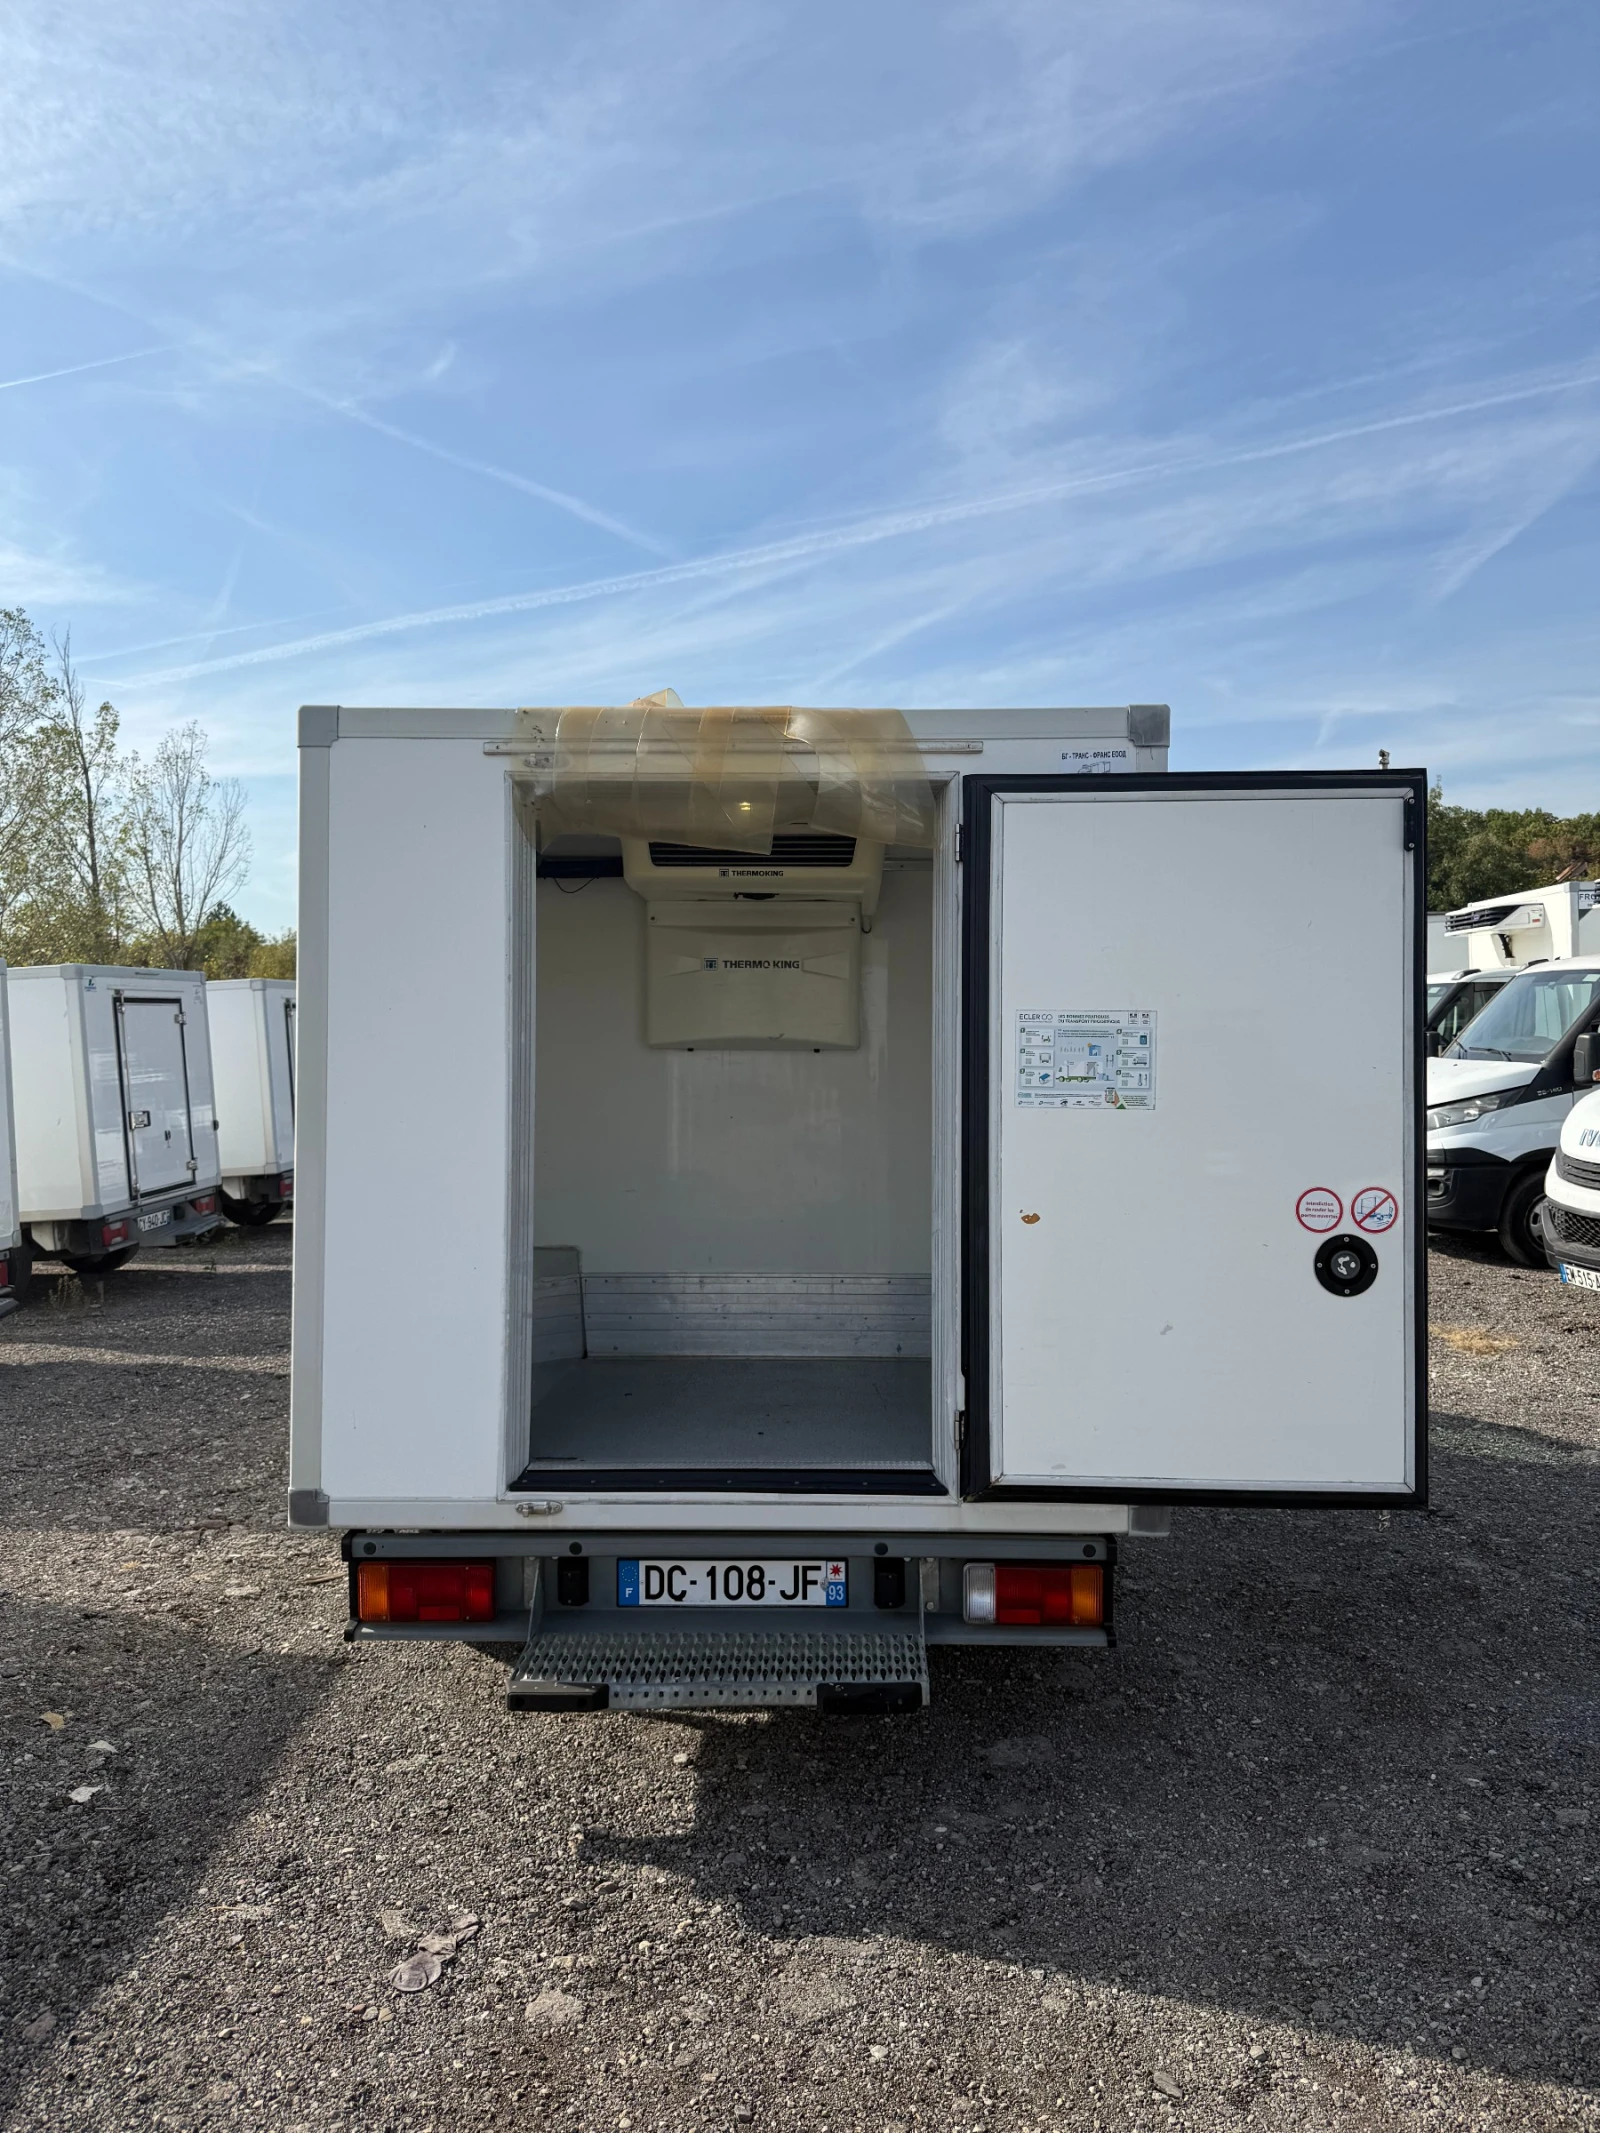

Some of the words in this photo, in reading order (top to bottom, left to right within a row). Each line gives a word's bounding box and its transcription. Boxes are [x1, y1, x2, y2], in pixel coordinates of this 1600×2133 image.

[1072, 752, 1089, 760] ТРАНС
[1092, 751, 1111, 759] ФРАНС
[722, 960, 771, 970] THERMO
[772, 960, 800, 969] KING
[1019, 1013, 1040, 1021] ECLER
[625, 1587, 633, 1598] F
[645, 1564, 822, 1602] DC-108-JF
[828, 1585, 844, 1601] 93
